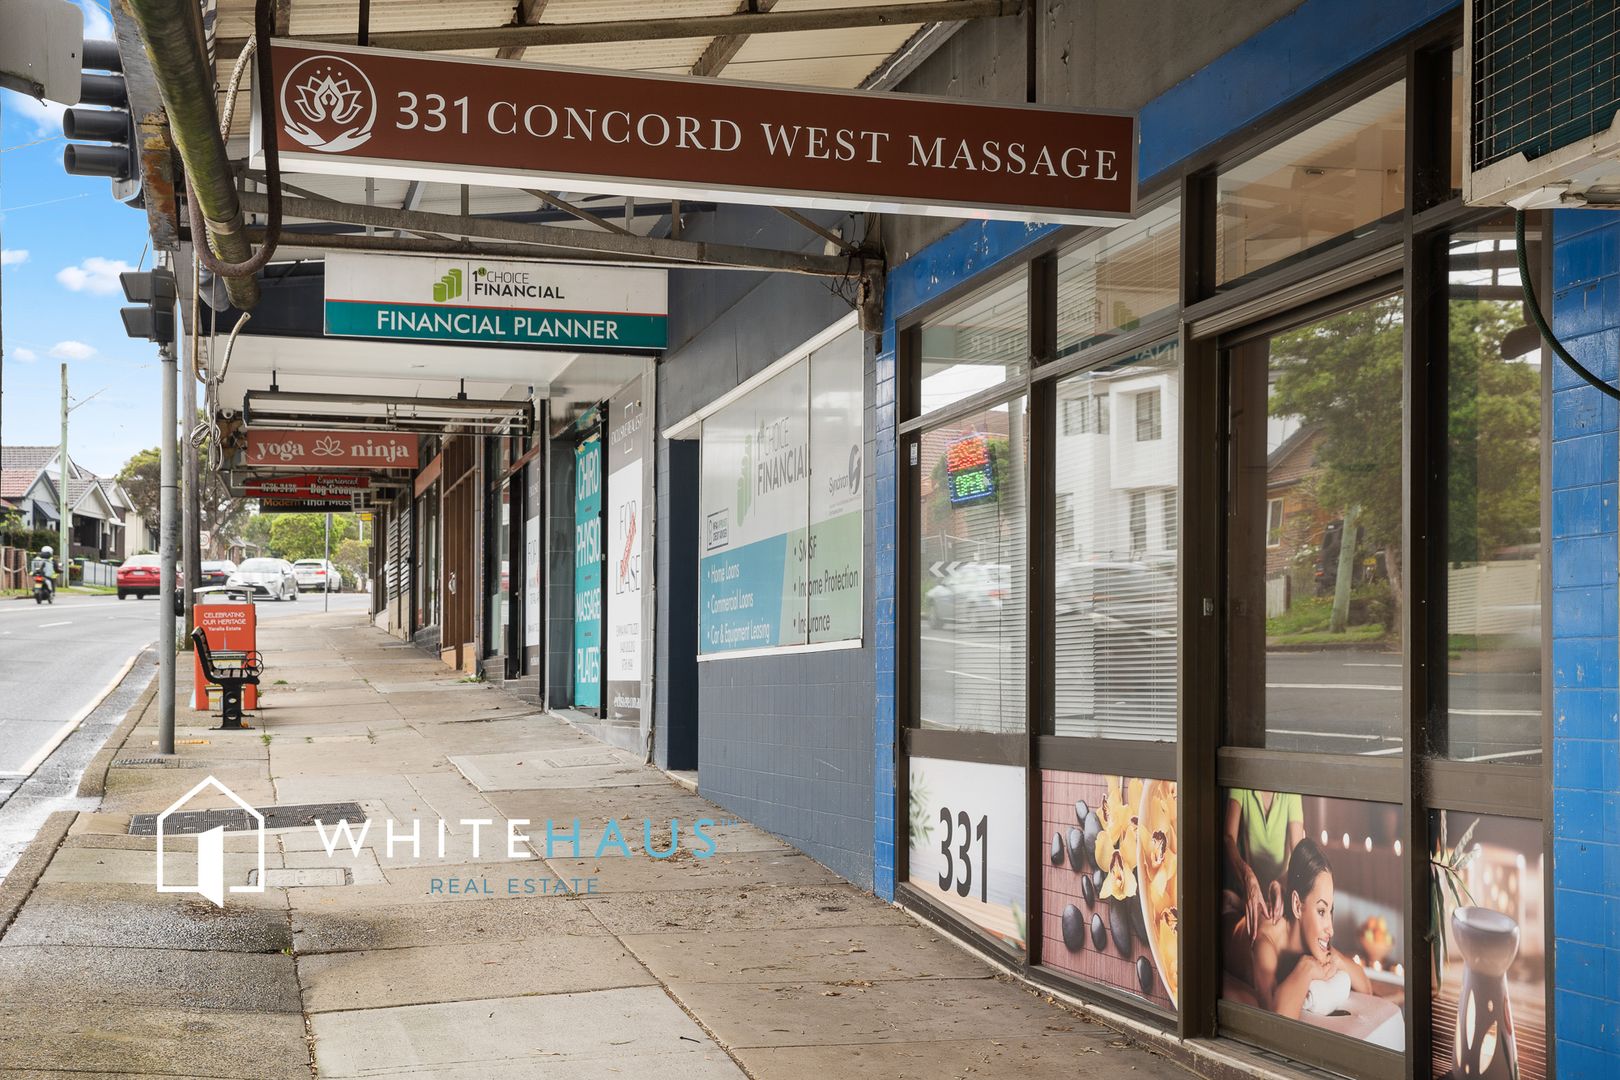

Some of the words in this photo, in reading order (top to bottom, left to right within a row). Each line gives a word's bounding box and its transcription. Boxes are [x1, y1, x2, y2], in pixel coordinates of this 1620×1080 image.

[395, 91, 469, 134] 331
[487, 101, 742, 152] CONCORD
[760, 122, 889, 164] WEST
[908, 135, 1119, 181] MASSAGE
[474, 283, 565, 299] FINANCIAL
[487, 271, 530, 285] CHOICE
[377, 310, 506, 336] FINANCIAL
[514, 317, 619, 341] PLANNER
[256, 440, 305, 461] yoga
[351, 439, 409, 463] ninja
[578, 448, 599, 501] CHIRO
[758, 442, 812, 496] FINANCIAL
[329, 484, 352, 495] Groo
[577, 517, 600, 568] PHYSIO
[711, 564, 725, 584] Home
[726, 560, 740, 580] Loans
[799, 575, 823, 597] Income
[824, 564, 859, 594] Protection
[576, 588, 601, 622] MASSAGE
[711, 588, 739, 614] Commercial
[739, 588, 754, 609] Loans
[711, 624, 720, 645] Car
[724, 621, 750, 649] Equipment
[750, 616, 770, 645] Leasing
[798, 612, 831, 633] Insurance
[577, 645, 600, 684] PILATES
[938, 806, 988, 904] 331
